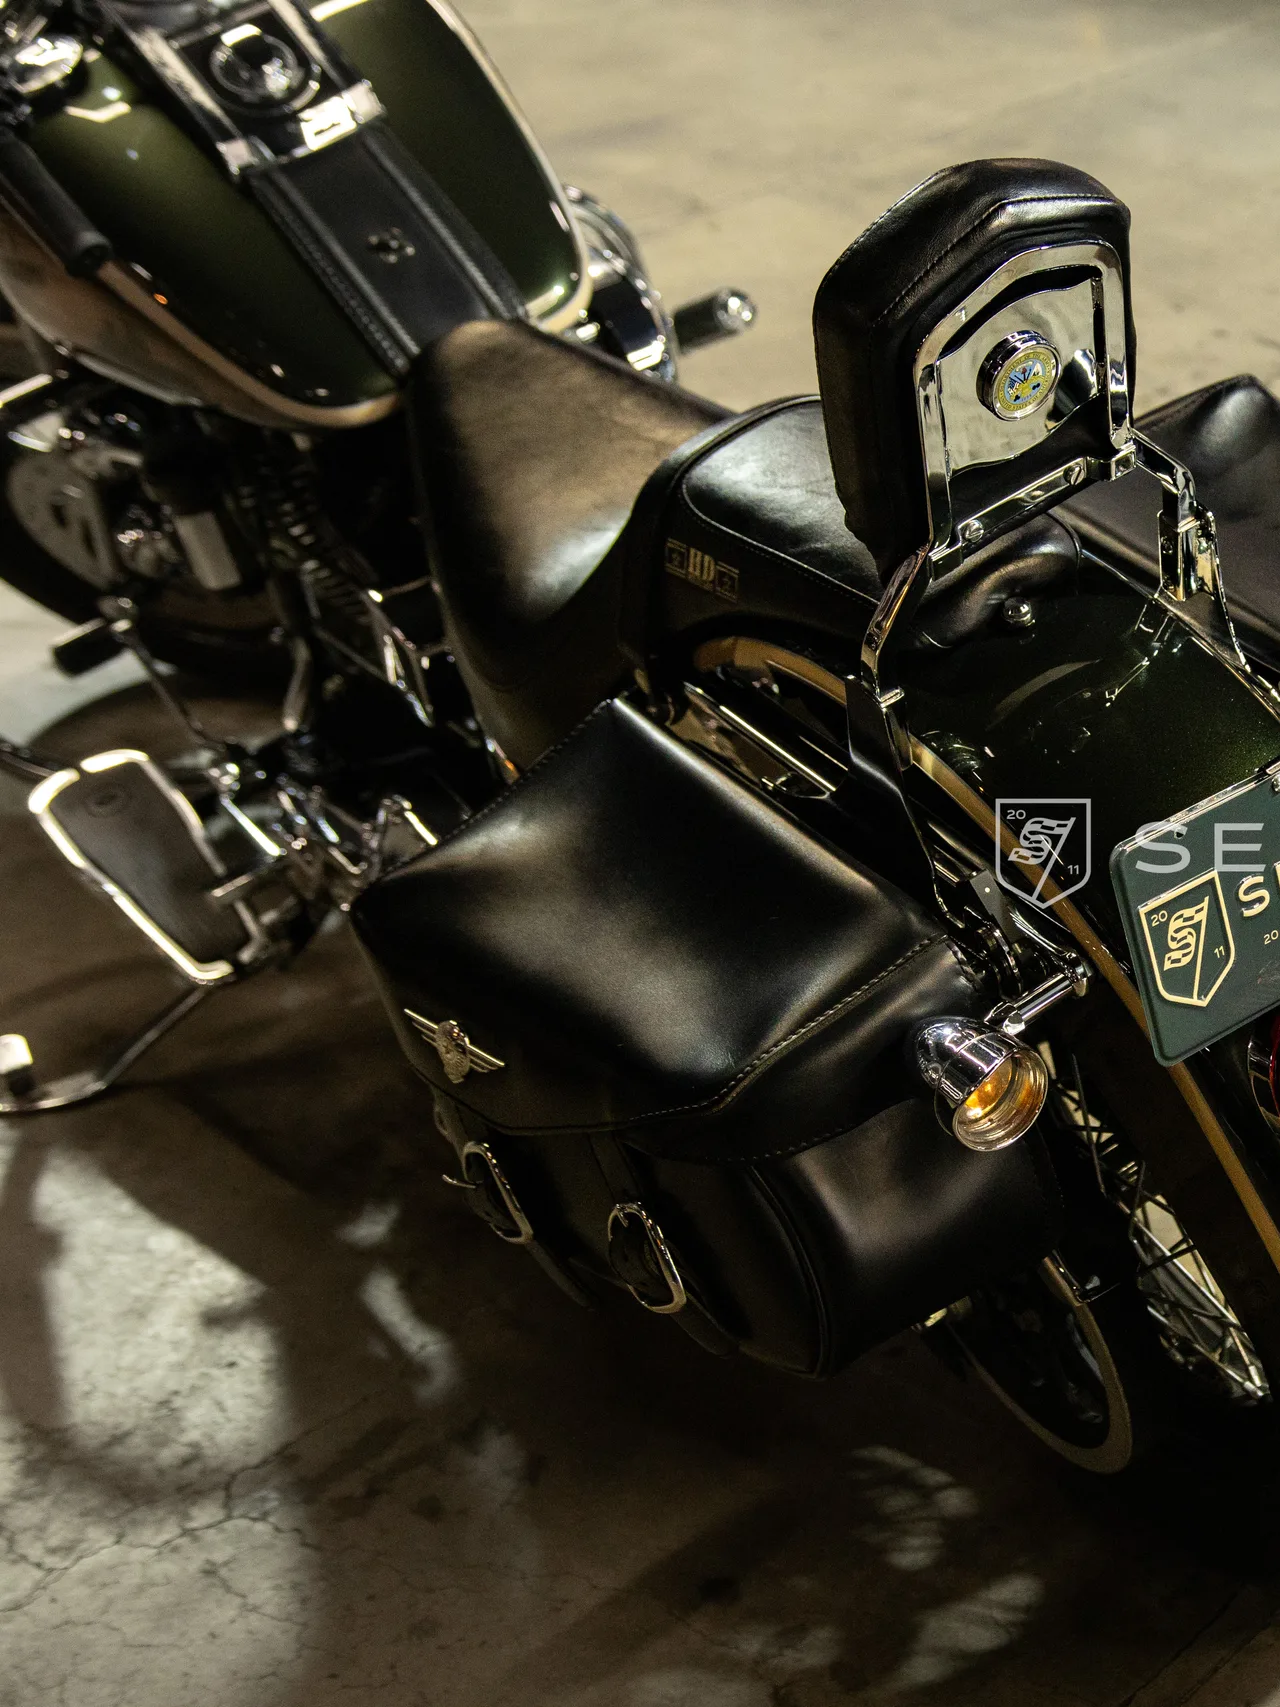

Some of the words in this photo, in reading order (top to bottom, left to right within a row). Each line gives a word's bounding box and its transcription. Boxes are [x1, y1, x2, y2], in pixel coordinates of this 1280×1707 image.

[1150, 910, 1168, 927] 20
[1263, 929, 1279, 945] 20
[1213, 945, 1225, 958] 11
